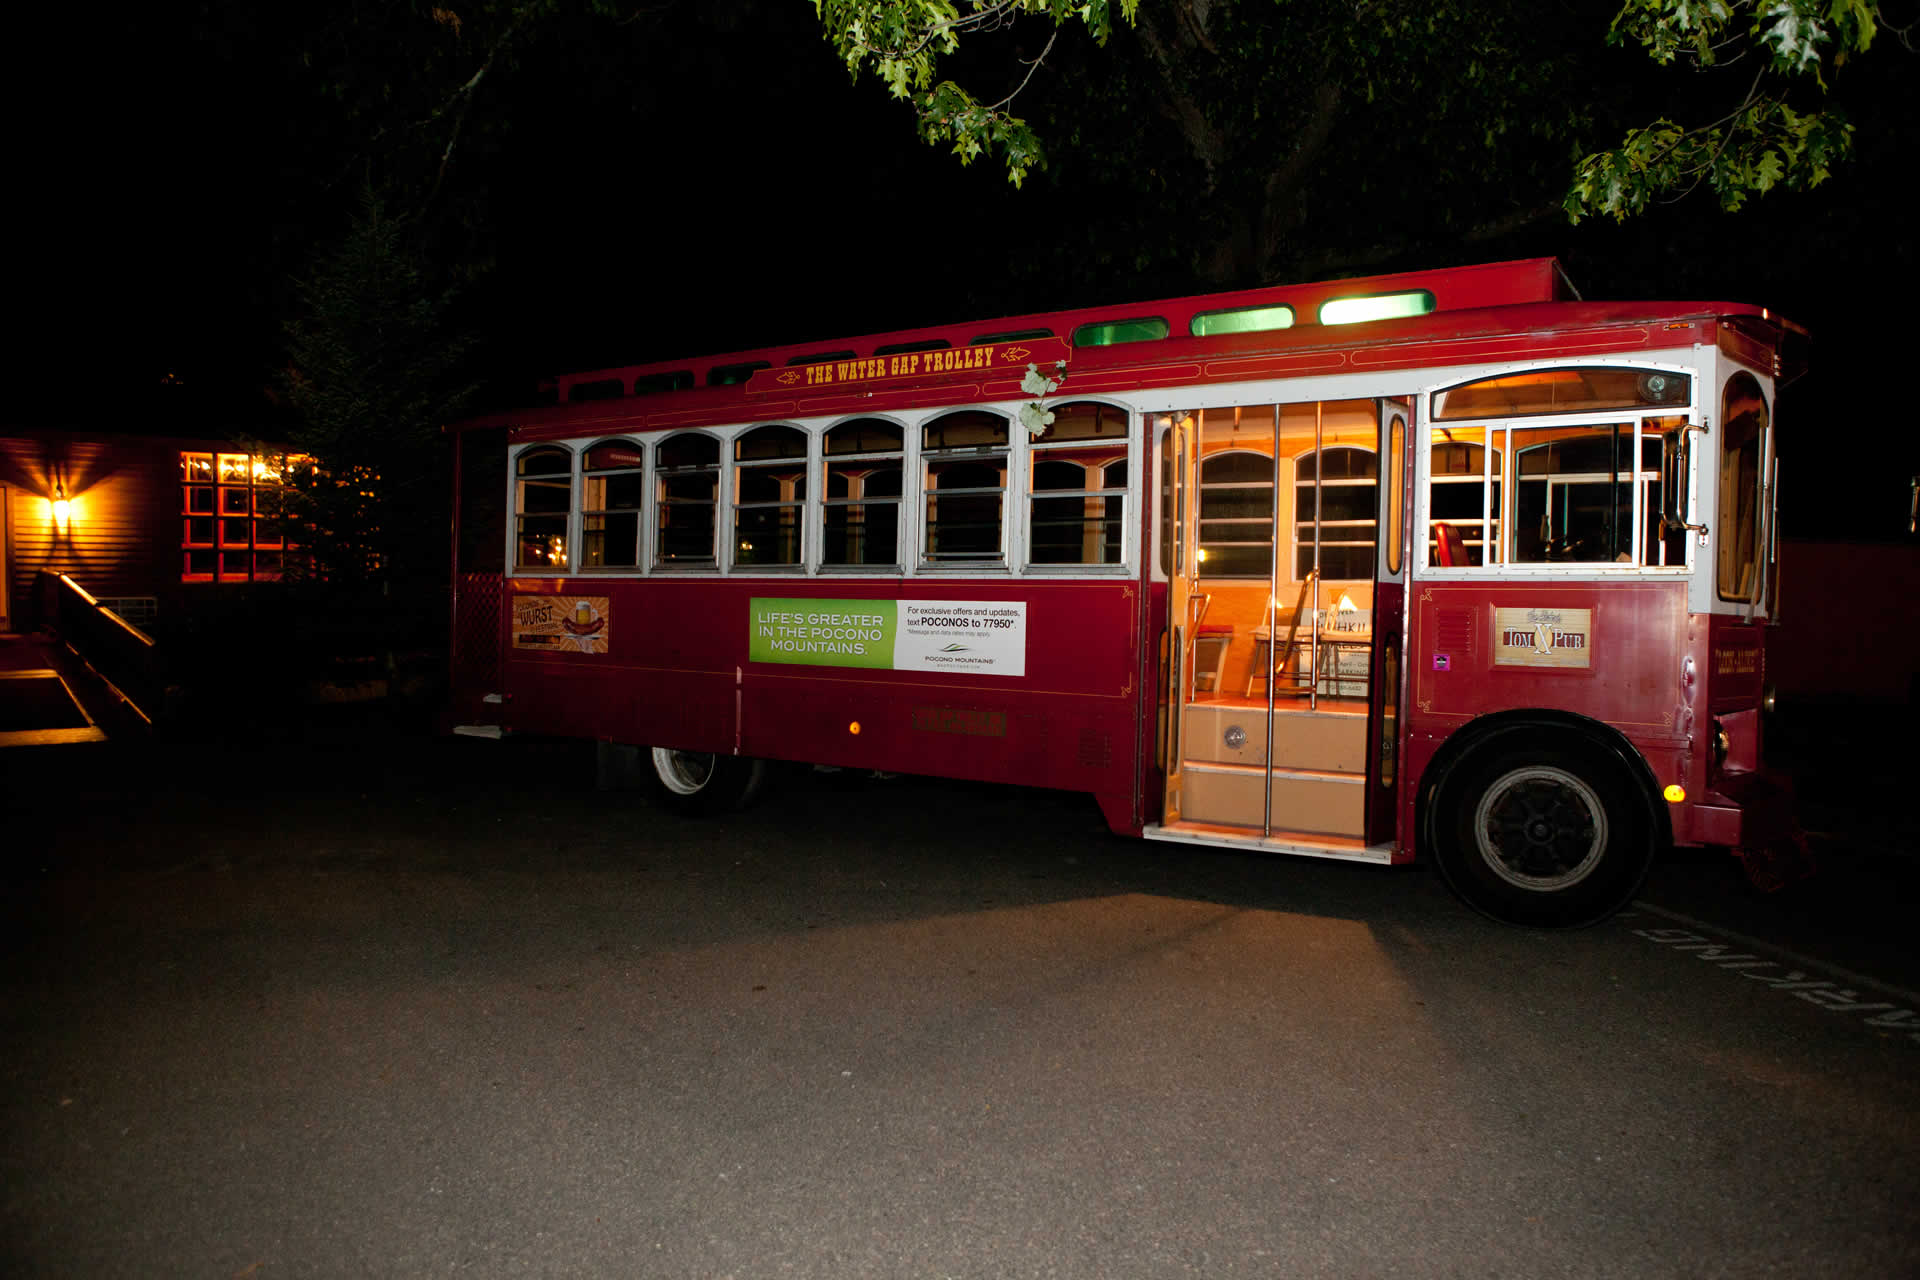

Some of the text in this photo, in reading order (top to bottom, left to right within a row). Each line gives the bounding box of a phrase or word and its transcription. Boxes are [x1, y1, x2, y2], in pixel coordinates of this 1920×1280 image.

[806, 347, 994, 385] THE WATER GAP TROLLEY
[520, 605, 553, 627] WURST
[758, 612, 884, 626] LIFE'S GREATER
[920, 607, 952, 615] exclusive
[953, 607, 972, 616] offers
[974, 608, 988, 616] and
[907, 618, 920, 626] text
[921, 617, 969, 628] POCONOS
[971, 618, 981, 628] to
[759, 626, 883, 641] IN THE POCONO
[1533, 623, 1552, 655] X
[770, 640, 869, 655] MOUNTAINS.
